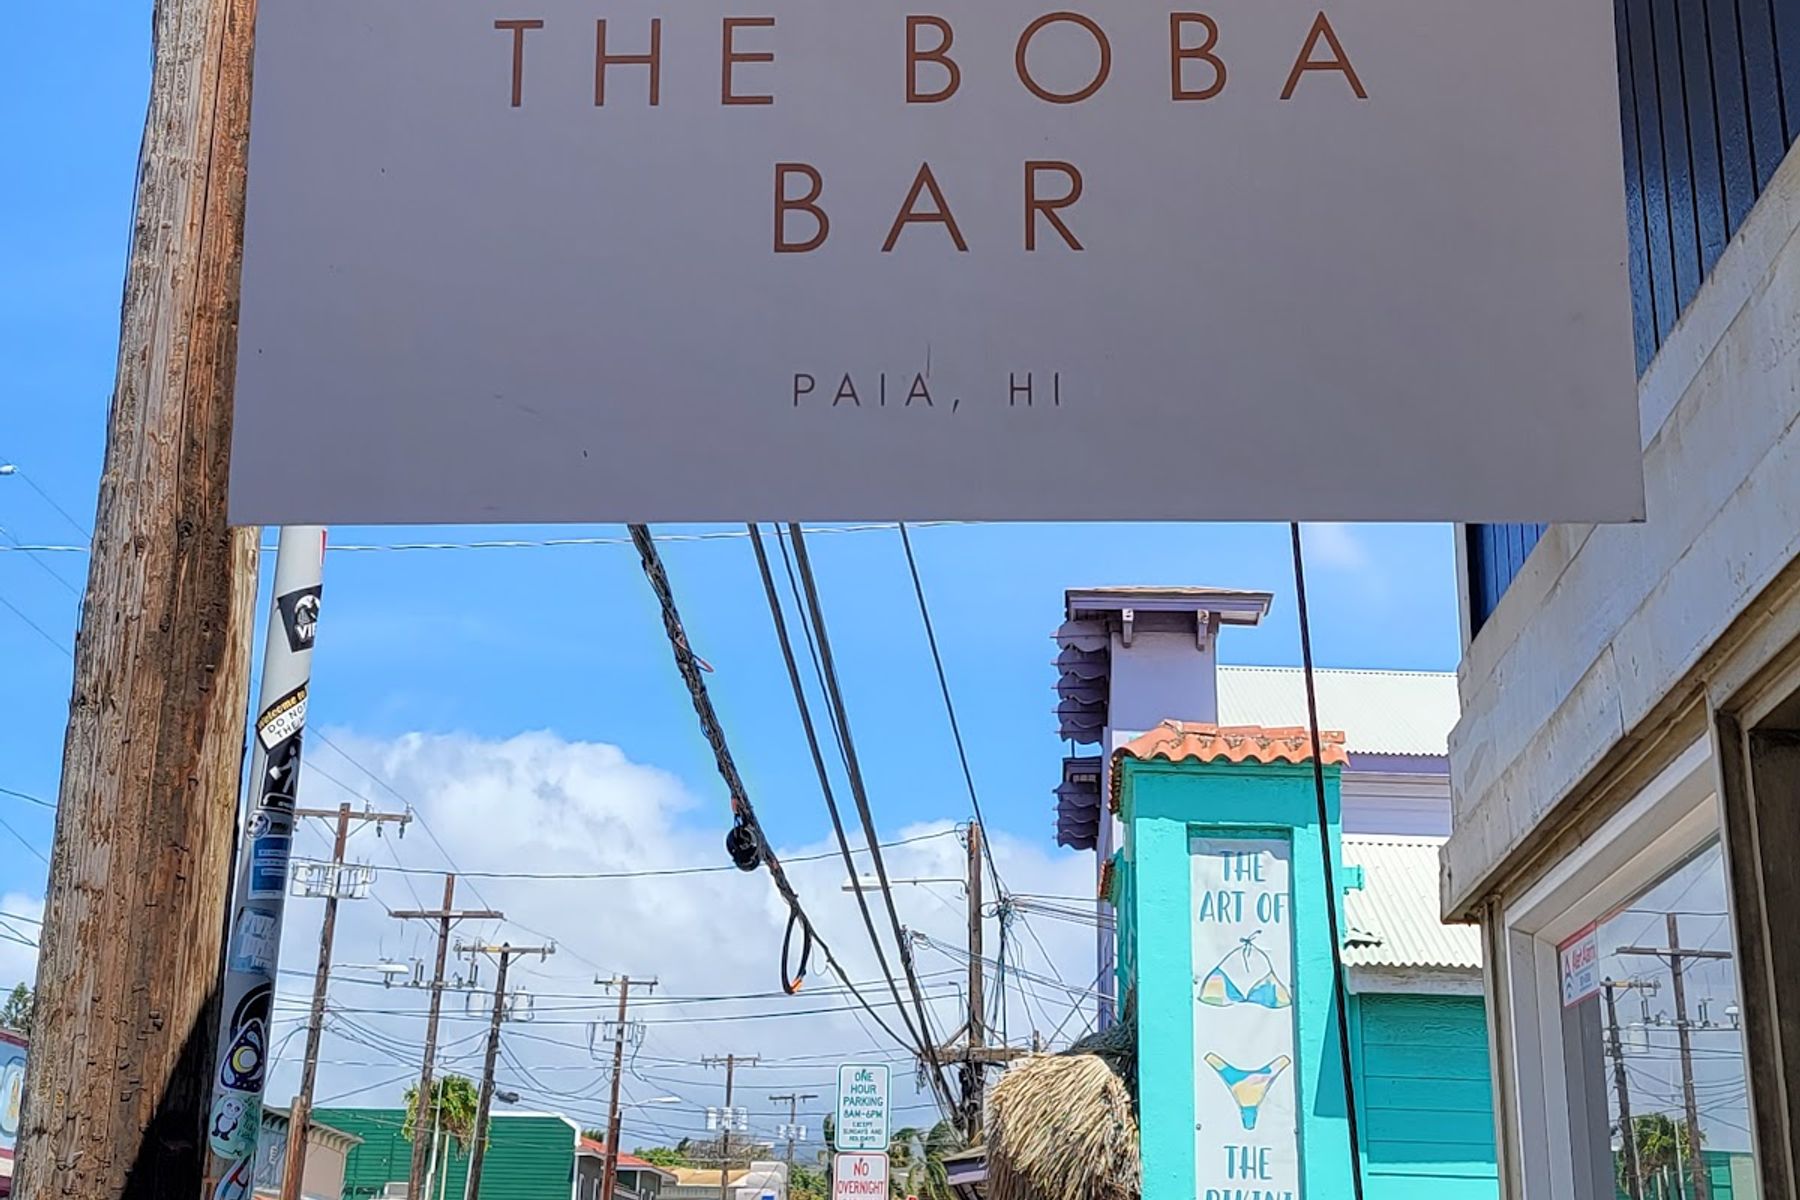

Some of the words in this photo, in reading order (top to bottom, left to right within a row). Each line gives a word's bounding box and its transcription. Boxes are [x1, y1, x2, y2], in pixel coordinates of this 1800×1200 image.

[494, 17, 776, 108] THE
[905, 10, 1369, 105] BOBA
[773, 160, 1085, 253] BAR
[792, 373, 959, 413] PAIA,
[1009, 372, 1061, 406] HI
[267, 718, 285, 733] DO
[1220, 850, 1266, 882] THE
[1199, 890, 1245, 924] ART
[1257, 892, 1289, 924] OF
[855, 1071, 874, 1082] ONE
[850, 1084, 877, 1094] HOUR
[843, 1096, 884, 1107] PARKING
[853, 1161, 869, 1177] NO
[1223, 1145, 1273, 1180] THE
[838, 1181, 884, 1194] OVERNIGHT
